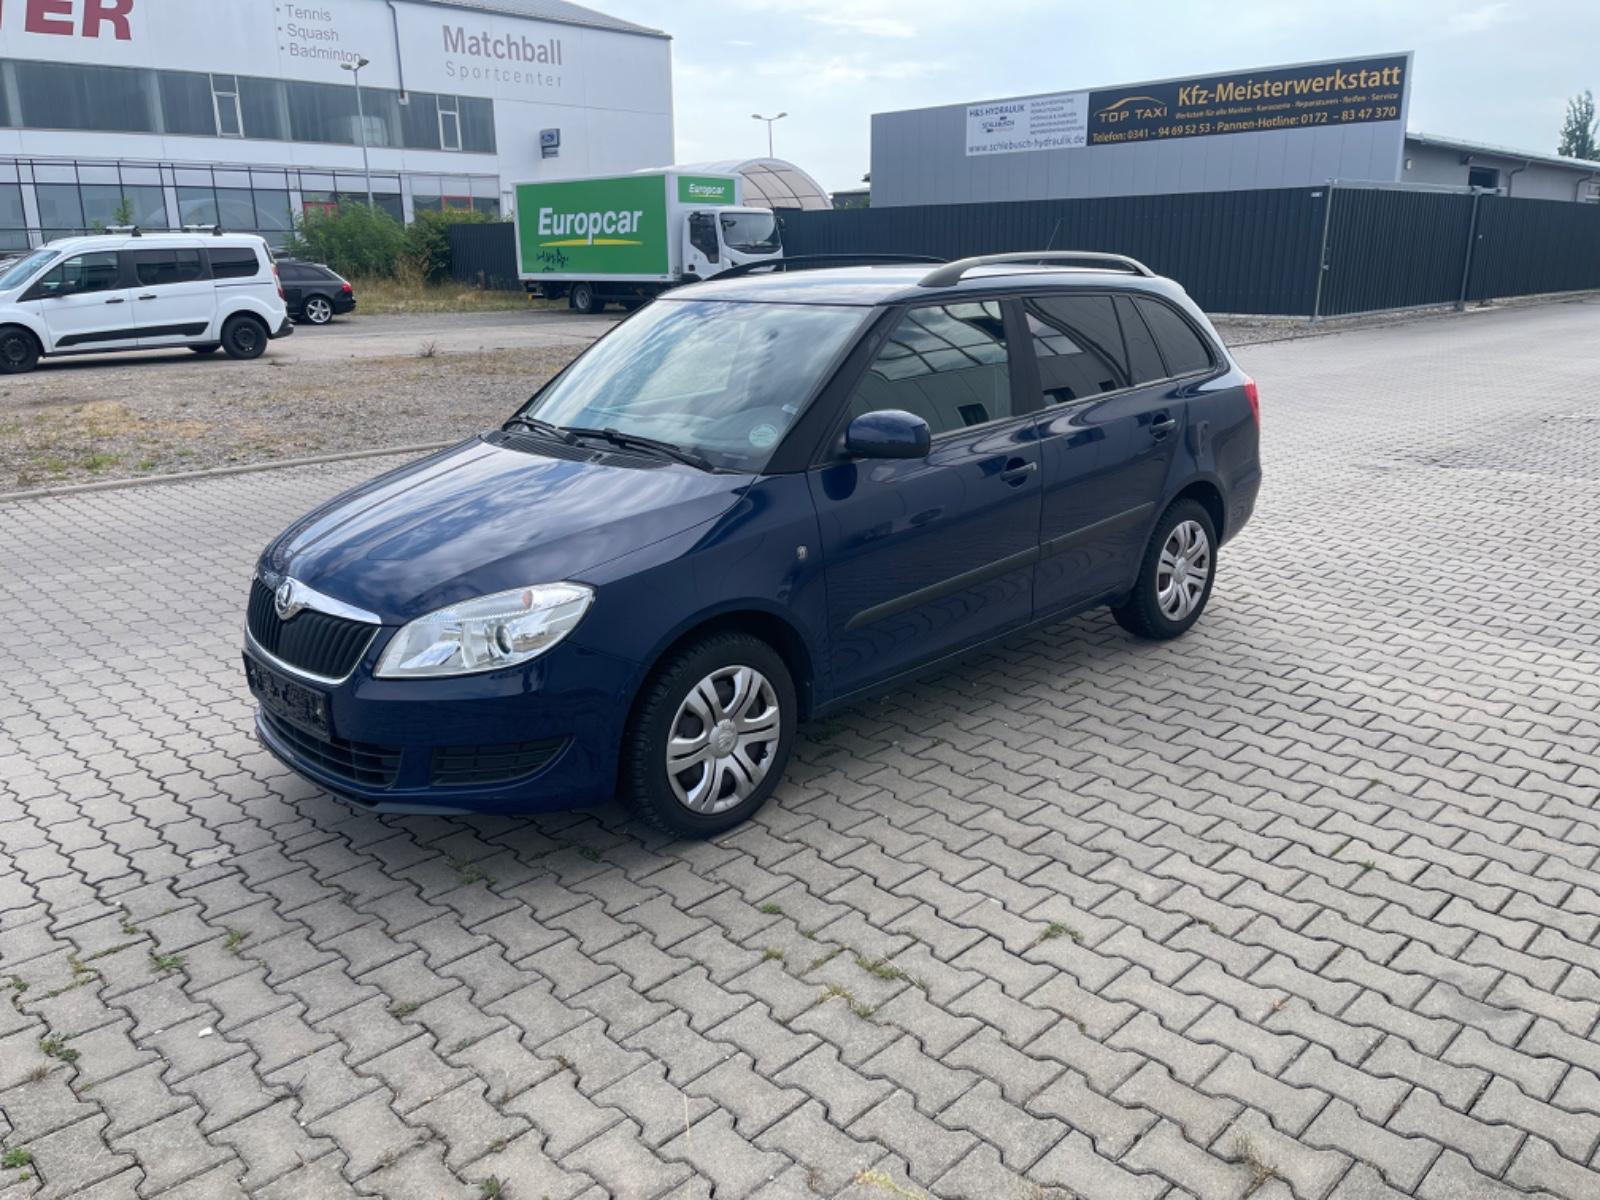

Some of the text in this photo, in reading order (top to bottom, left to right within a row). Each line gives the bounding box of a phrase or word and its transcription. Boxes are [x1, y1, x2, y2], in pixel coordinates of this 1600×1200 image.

[284, 4, 332, 22] Tennis
[287, 23, 339, 41] Squash
[289, 42, 361, 62] Badminton
[442, 25, 562, 65] Matchball
[446, 60, 561, 87] Sportcenter
[1178, 66, 1402, 107] Kfz-Meisterwerkstatt
[1370, 91, 1398, 102] Service
[1099, 106, 1168, 123] TOP TAXI
[1092, 131, 1127, 144] Telefon:
[1127, 128, 1149, 140] 0341
[1158, 126, 1170, 138] 94
[1171, 125, 1183, 136] 69
[1185, 123, 1197, 135] 52
[1199, 122, 1211, 133] 53
[1216, 115, 1299, 131] Pannen-Hotline:
[1300, 112, 1328, 124] 0172
[1341, 110, 1355, 121] 83
[1358, 108, 1372, 119] 47
[1374, 106, 1397, 118] 370
[689, 183, 725, 197] Europcar
[538, 206, 643, 245] Europcar
